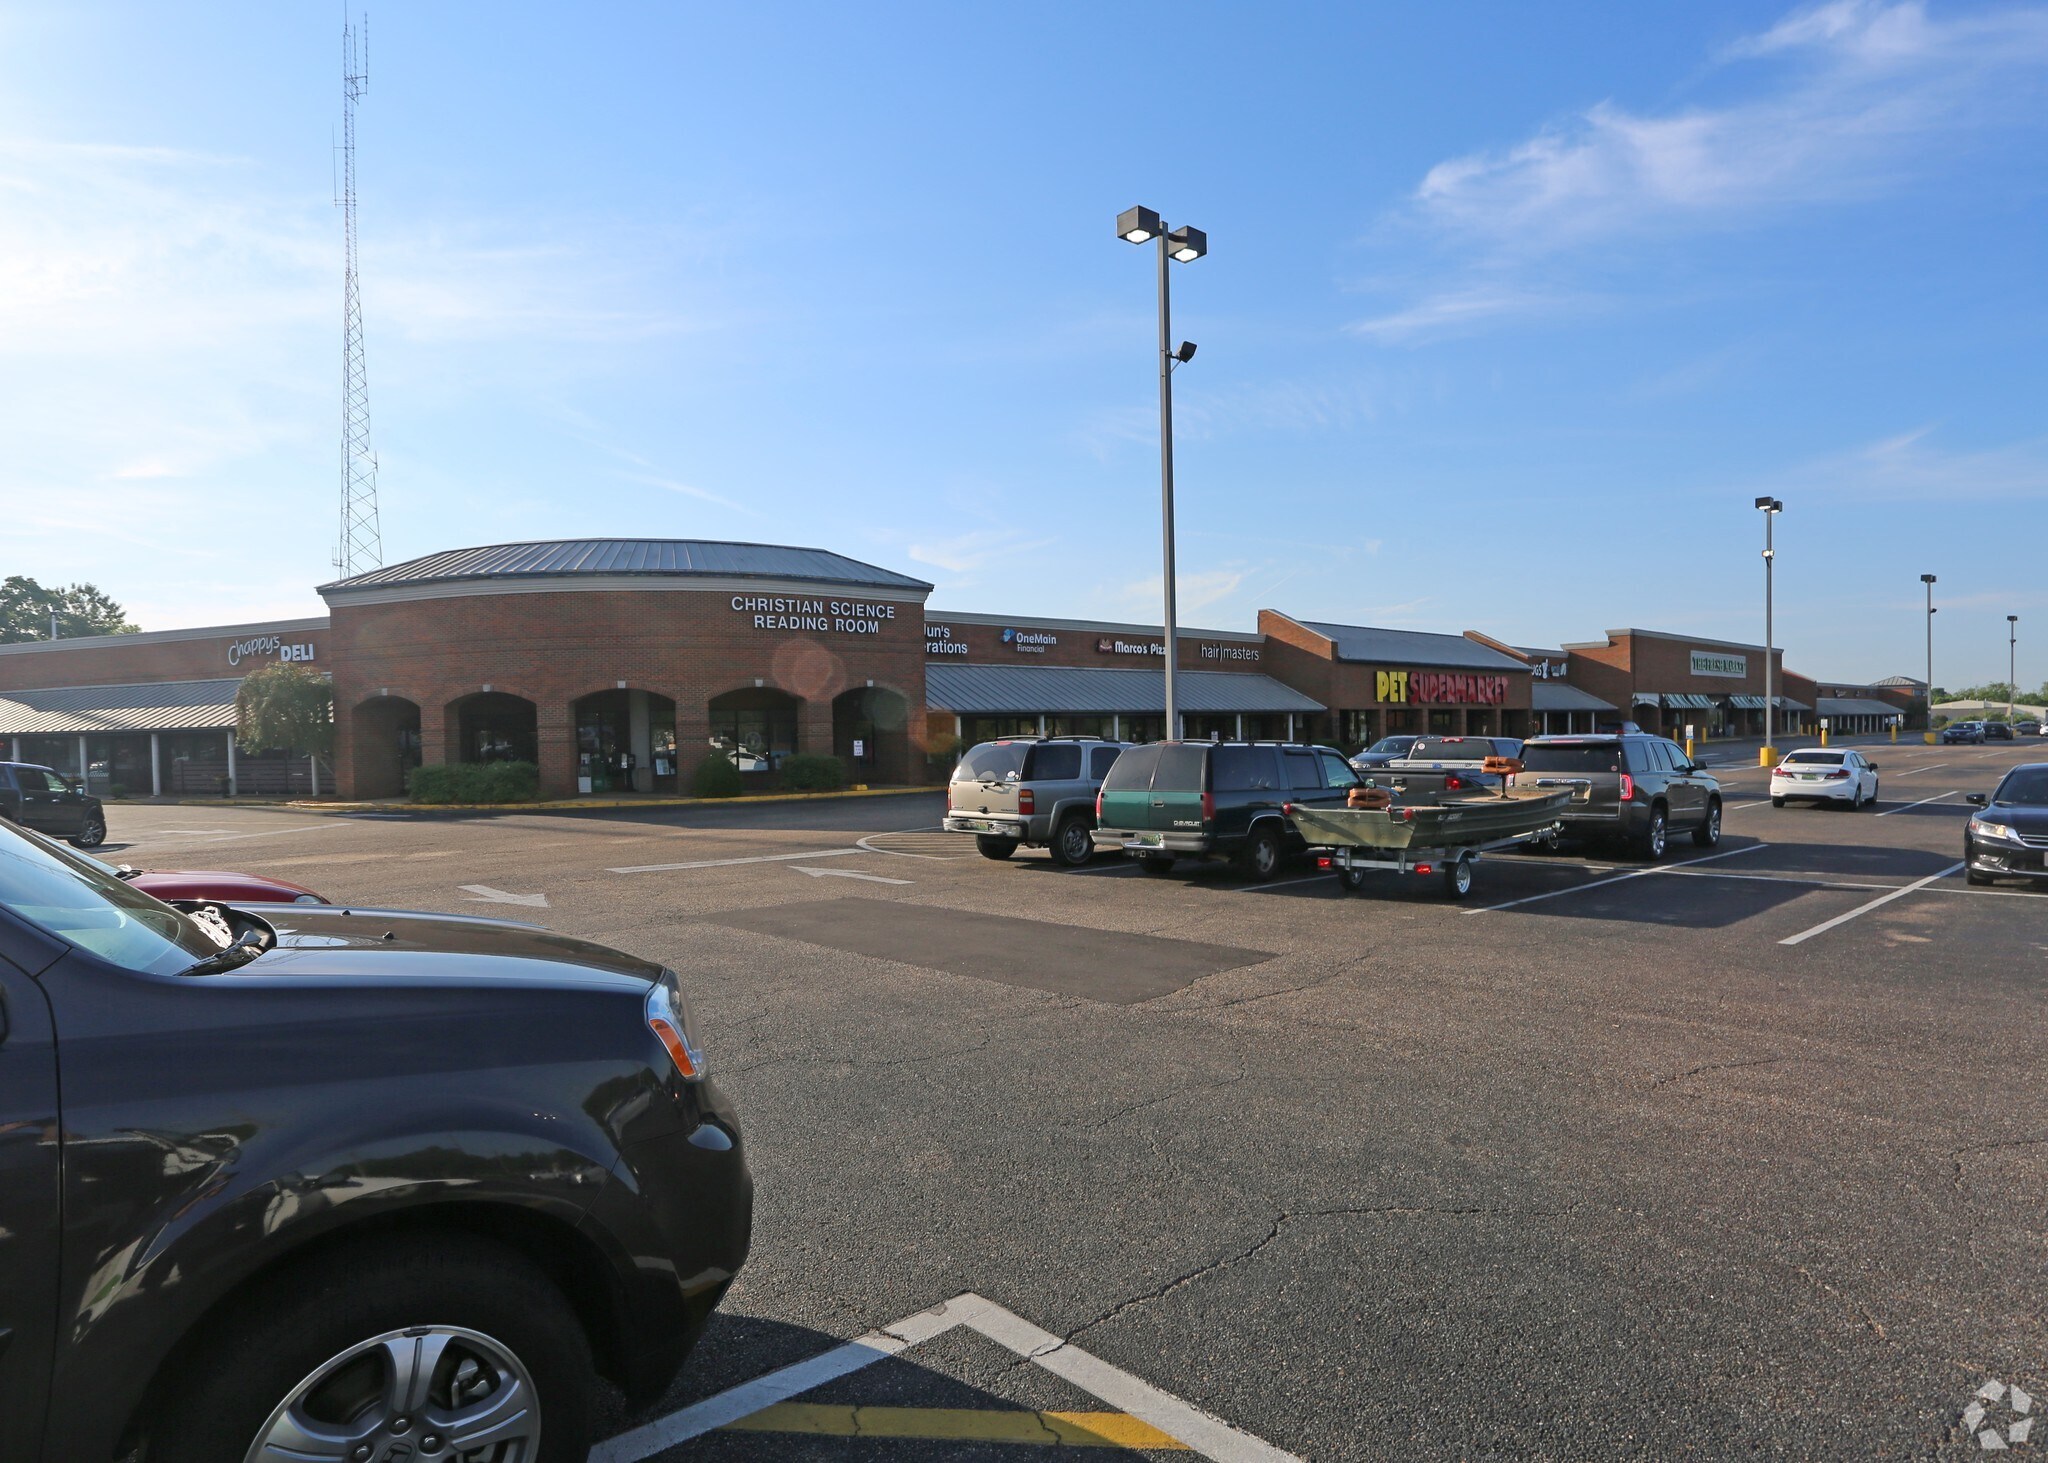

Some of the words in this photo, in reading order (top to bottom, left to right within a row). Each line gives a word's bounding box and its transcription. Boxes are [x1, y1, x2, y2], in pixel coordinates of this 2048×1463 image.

[731, 596, 823, 614] CHRISTIAN
[830, 601, 895, 619] SCIENCE
[754, 615, 828, 631] READING
[835, 618, 879, 633] ROOM
[924, 639, 968, 654] rations
[1016, 632, 1057, 645] OneMain
[1114, 640, 1148, 655] Marco's
[1150, 642, 1166, 655] Pizz
[228, 635, 280, 666] Chappy's
[280, 643, 314, 662] DELI
[1017, 644, 1045, 653] Financial
[1376, 671, 1408, 703] PET
[1409, 671, 1509, 705] SUPERMARKET
